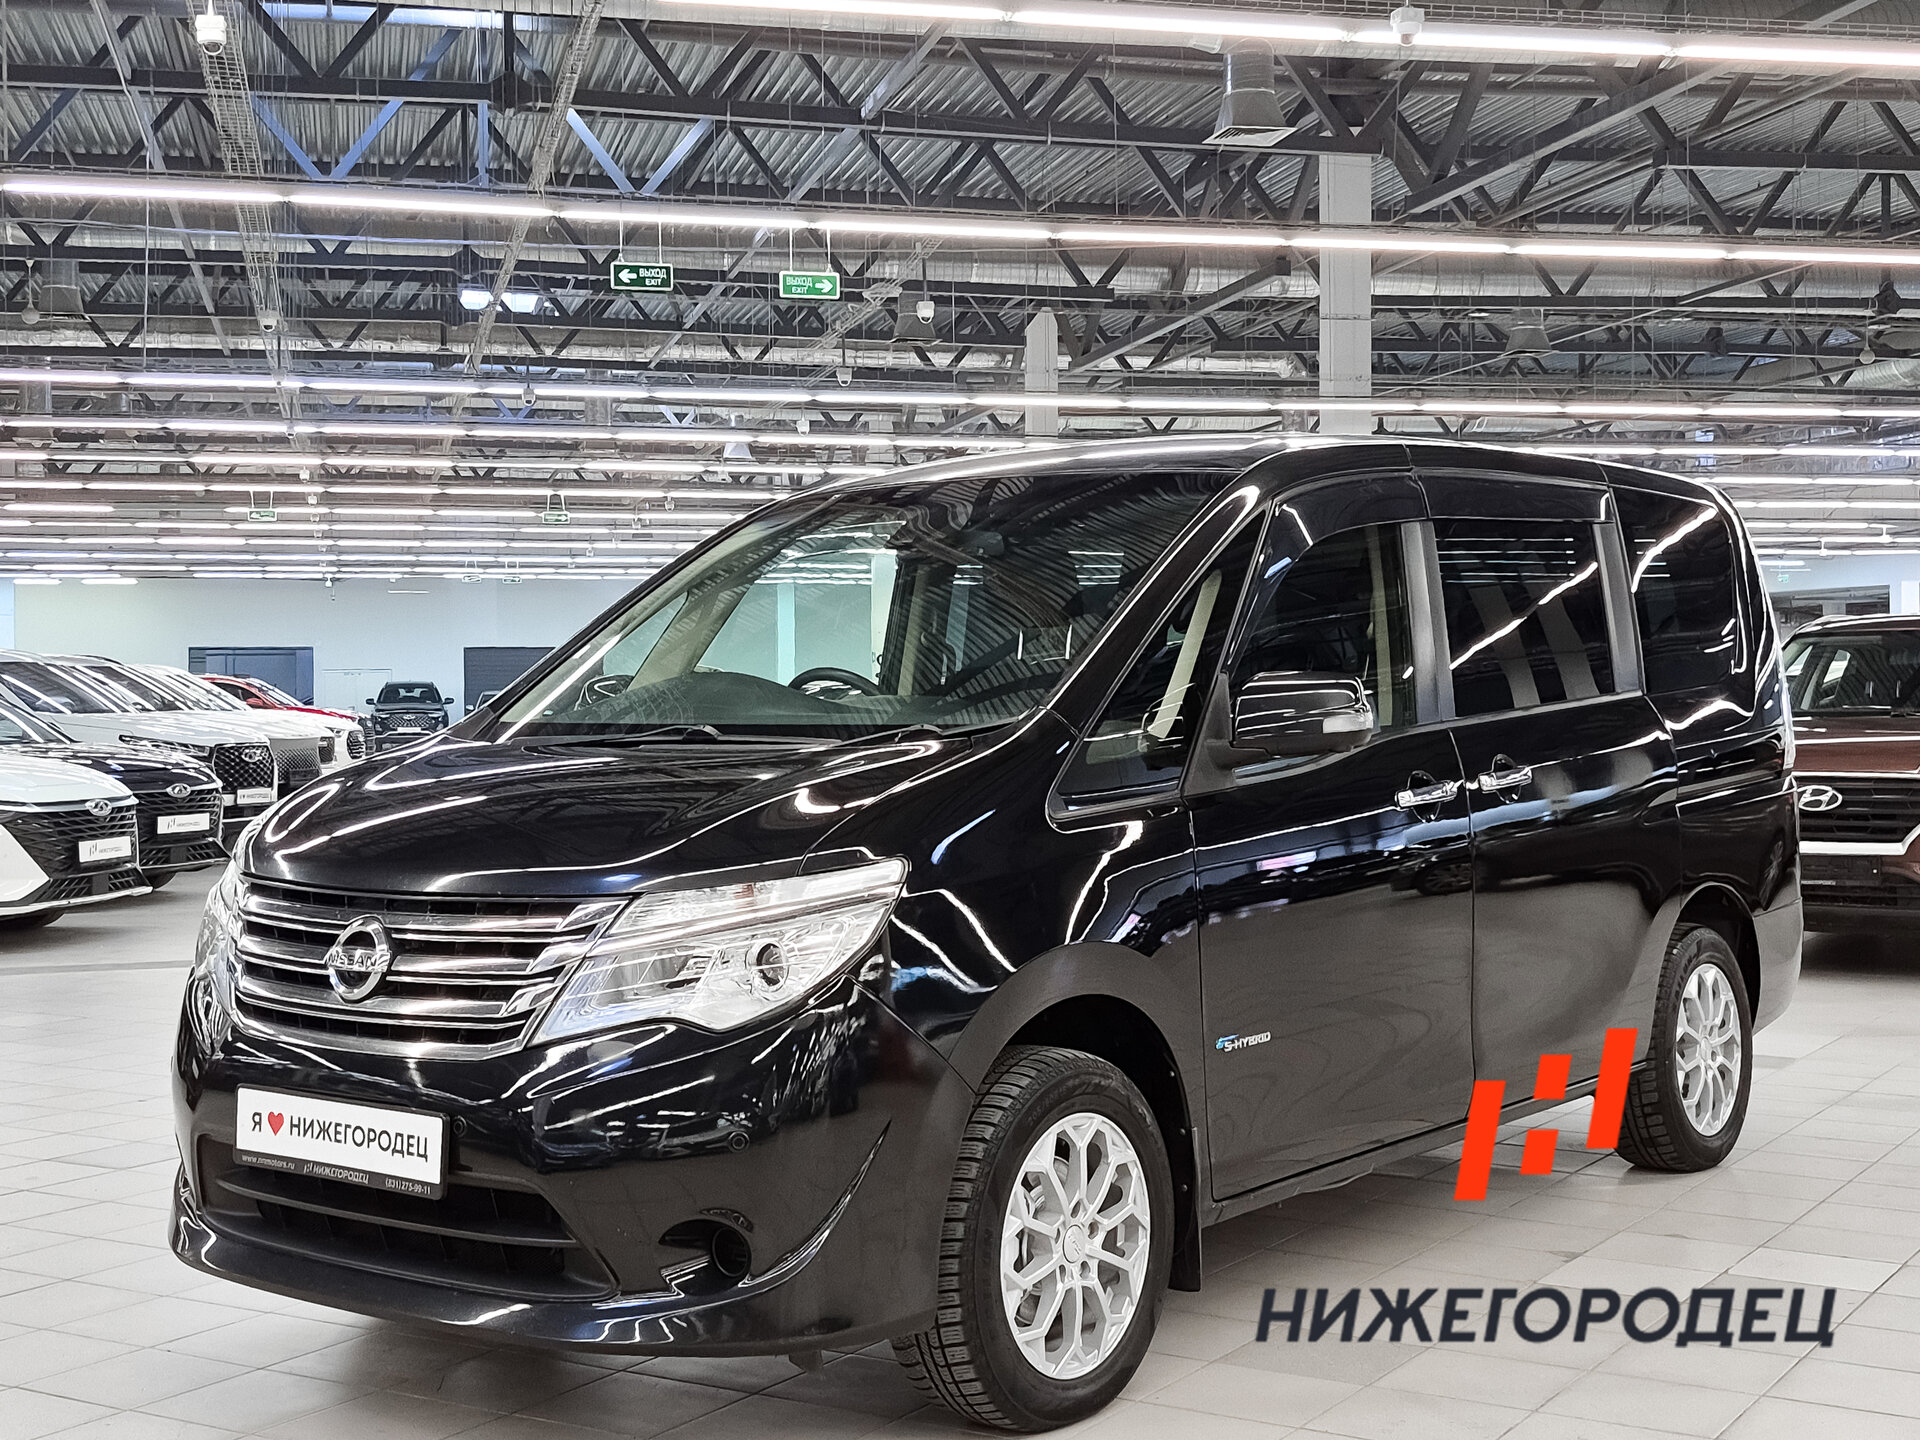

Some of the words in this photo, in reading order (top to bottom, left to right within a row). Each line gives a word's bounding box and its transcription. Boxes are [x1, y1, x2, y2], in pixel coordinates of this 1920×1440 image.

[639, 268, 667, 279] ВЫХОД
[645, 278, 662, 286] EXIT
[786, 276, 813, 288] ВЫХОД
[791, 286, 807, 294] EXIT
[1224, 1032, 1271, 1052] S-HYBRID
[252, 1112, 262, 1132] Я
[290, 1115, 428, 1163] НИЖЕГОРОДЕЦ
[313, 1163, 369, 1184] НИЖЕГОРОДЕЦ
